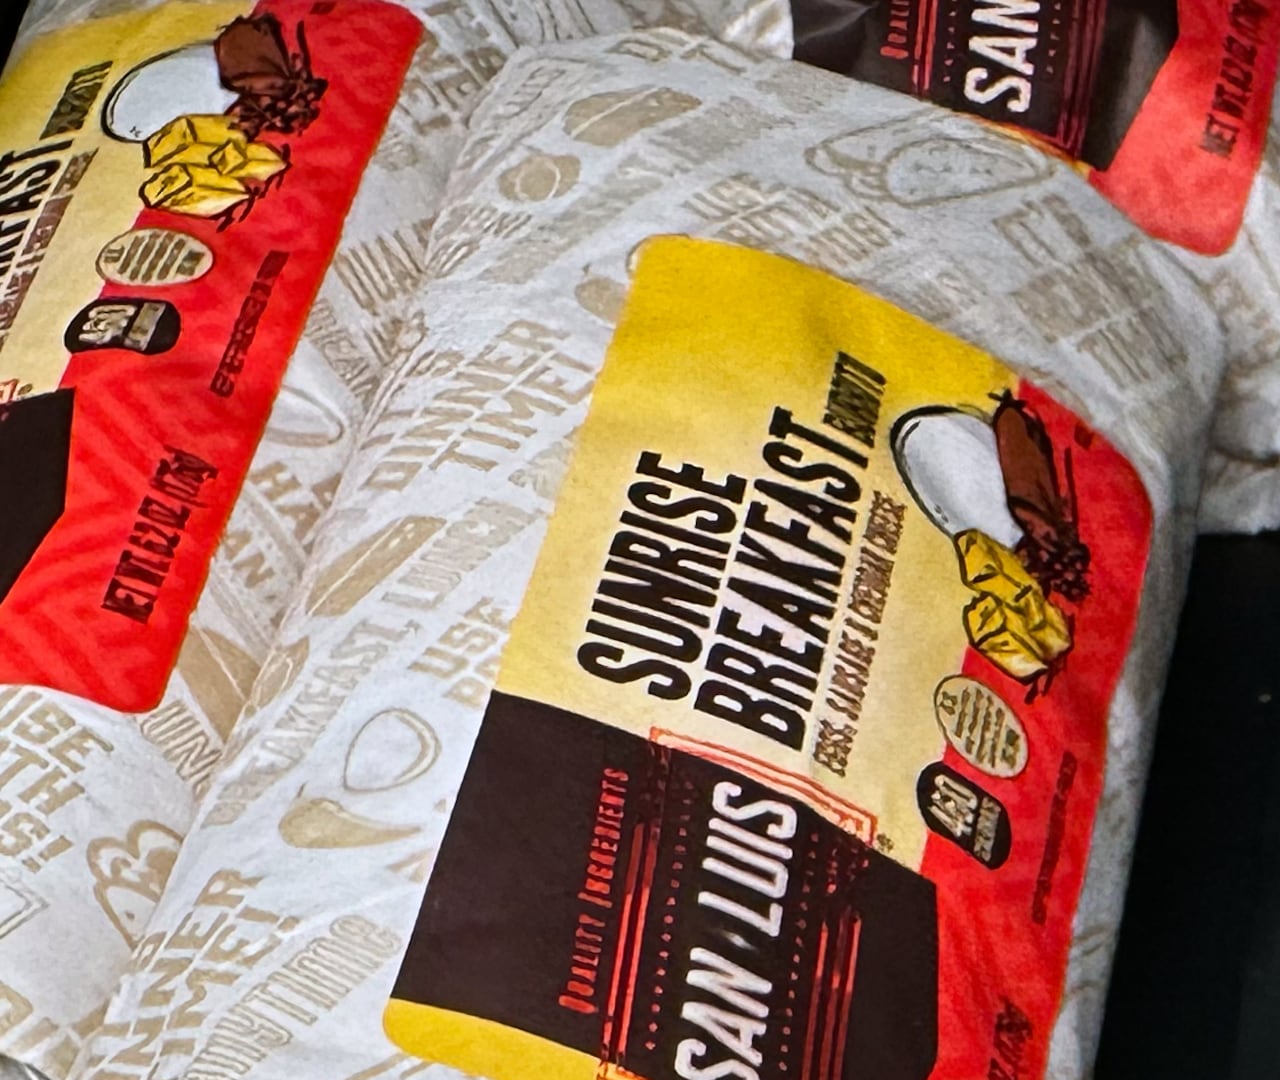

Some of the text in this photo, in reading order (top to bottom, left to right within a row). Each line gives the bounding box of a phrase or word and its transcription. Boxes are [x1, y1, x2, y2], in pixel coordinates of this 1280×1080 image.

[964, 0, 1040, 113] SAN
[576, 451, 747, 701] SUNRISE
[692, 405, 869, 752] BREAKFAST
[697, 780, 799, 938] LUIS
